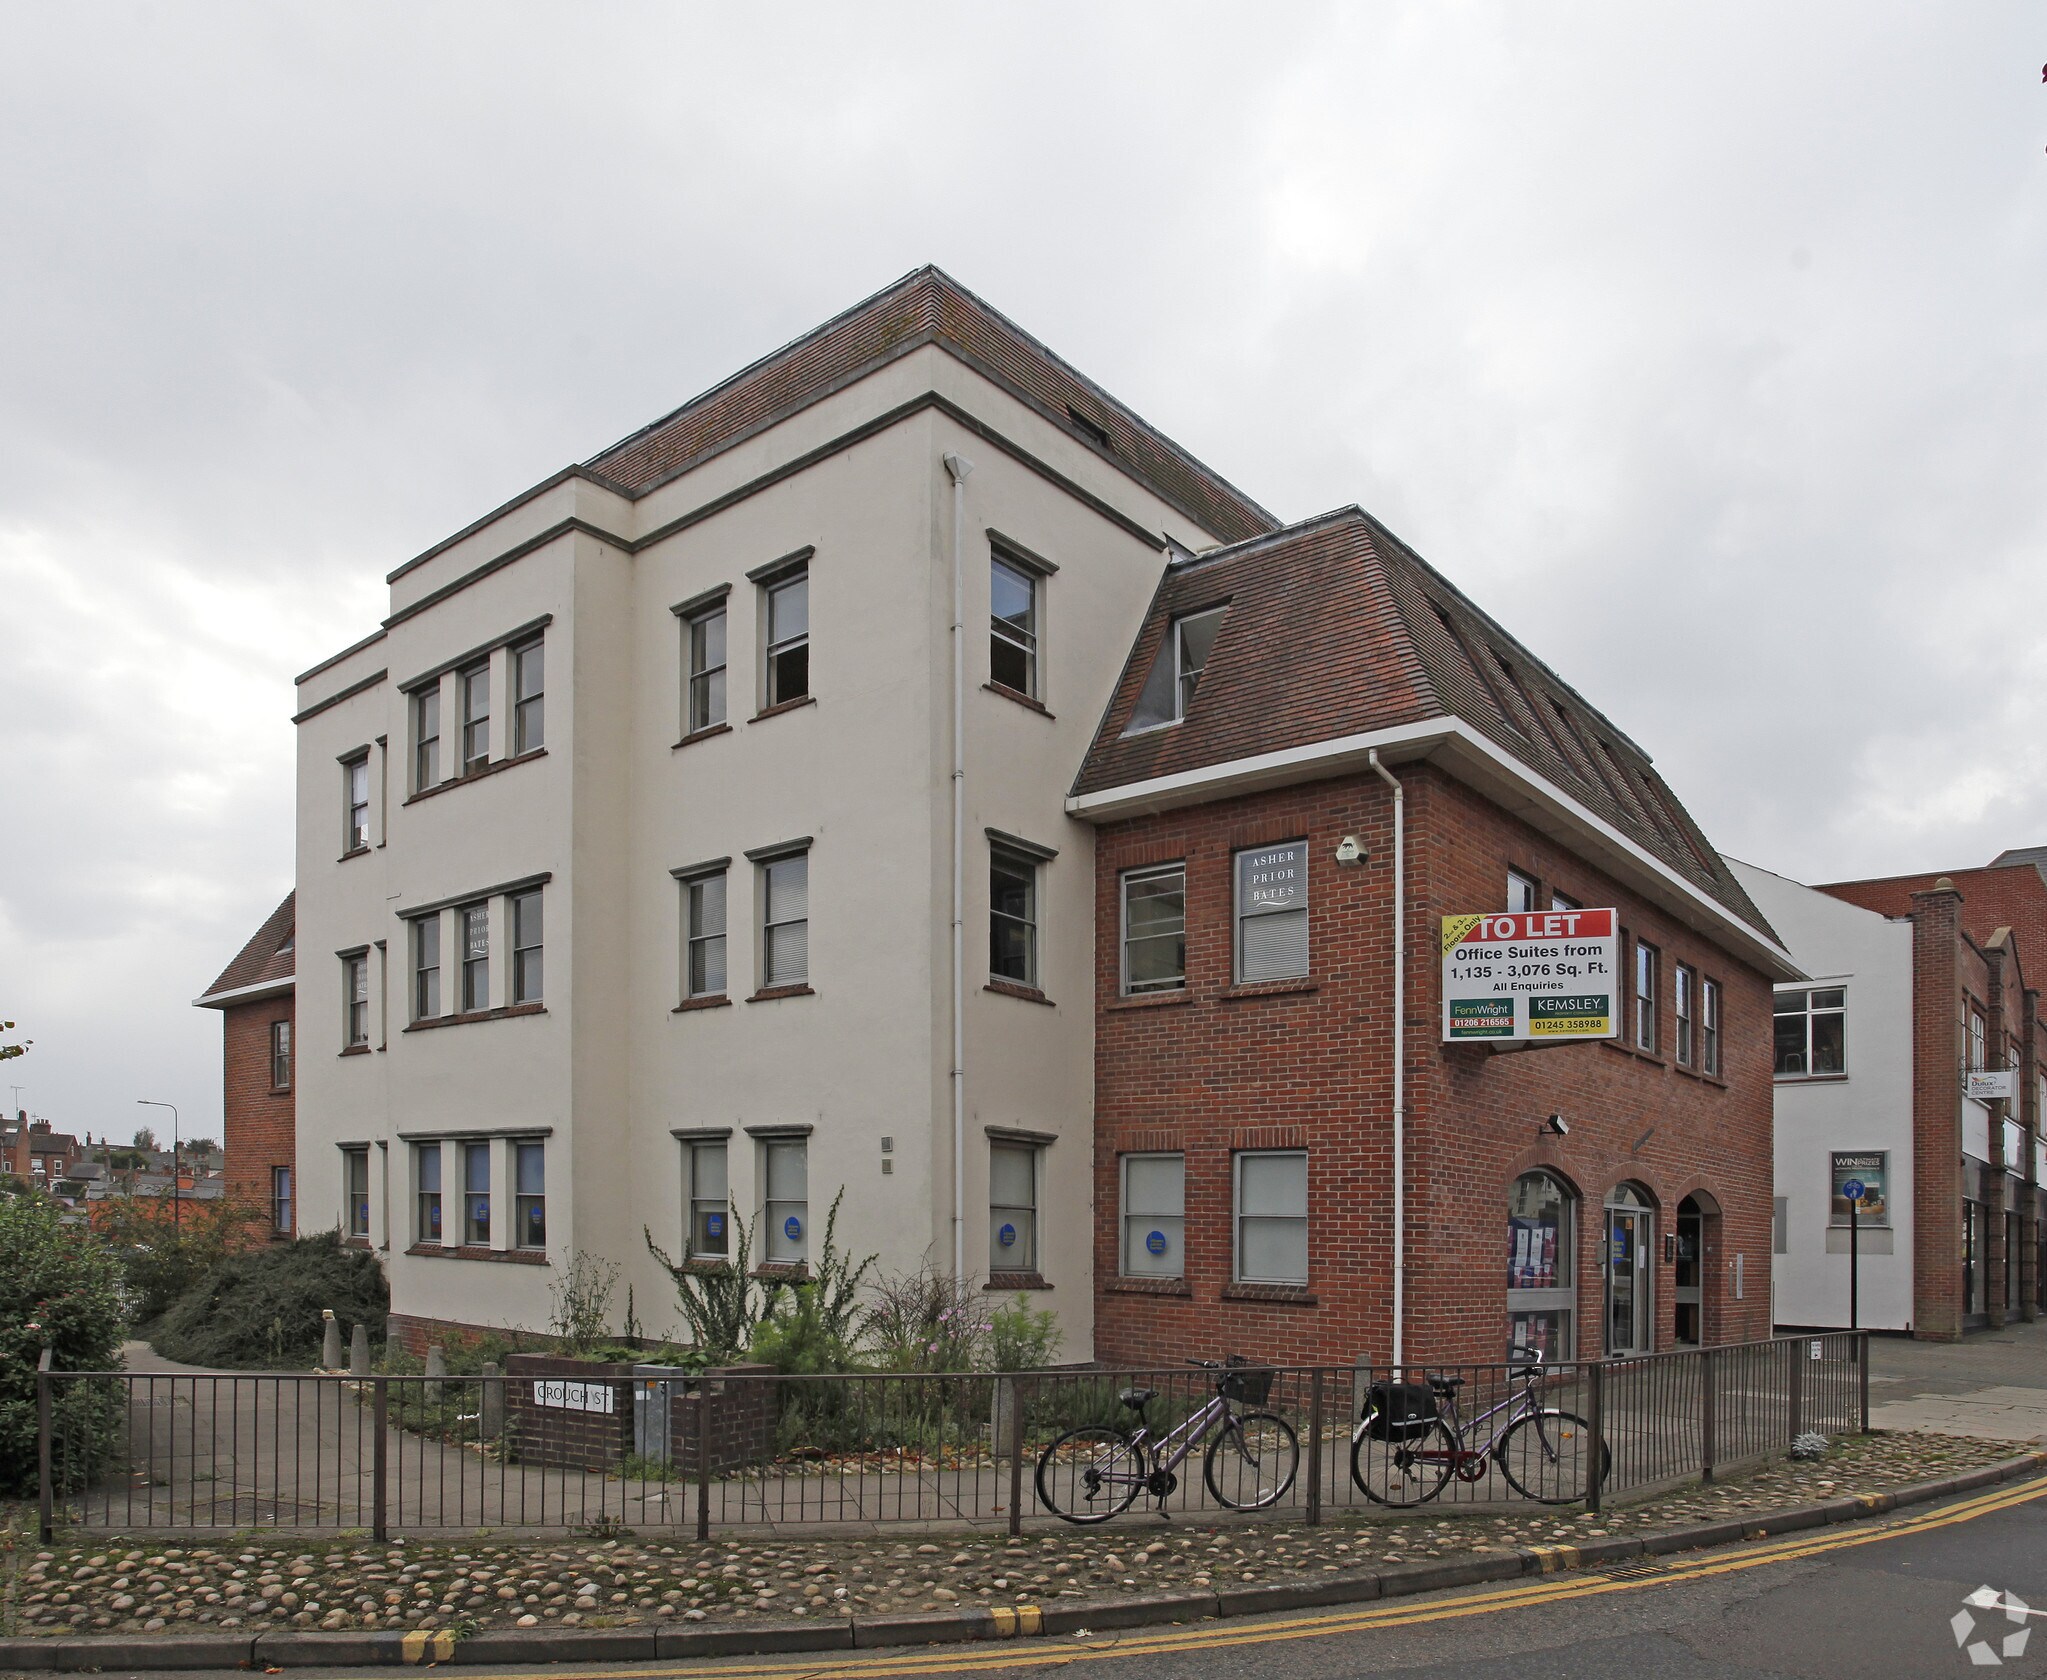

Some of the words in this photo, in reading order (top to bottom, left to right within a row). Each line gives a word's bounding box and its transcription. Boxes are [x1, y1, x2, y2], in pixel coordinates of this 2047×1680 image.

[1252, 851, 1295, 867] ASHER
[1253, 868, 1295, 884] PRIOR
[1253, 886, 1294, 901] BATES
[1443, 930, 1466, 952] Floors
[1464, 915, 1481, 931] Only
[1478, 917, 1516, 939] TO
[1526, 914, 1581, 937] LET
[1455, 948, 1503, 961] Office
[1508, 946, 1559, 959] Suites
[1564, 944, 1603, 957] from
[1451, 966, 1492, 980] 1,135
[1507, 964, 1551, 979] 3,076
[1556, 963, 1582, 978] Sq.
[1588, 962, 1608, 974] Ft.
[1493, 983, 1507, 992] All
[1511, 981, 1564, 992] Enquiries
[1454, 1005, 1508, 1016] FennWright
[1537, 998, 1600, 1011] KEMSLEY
[1454, 1018, 1479, 1027] 01206
[1480, 1017, 1510, 1027] 216565
[1535, 1021, 1564, 1030] 01245
[1567, 1019, 1602, 1029] 358988
[1835, 1157, 1858, 1166] WIN
[537, 1385, 588, 1404] CROUCH
